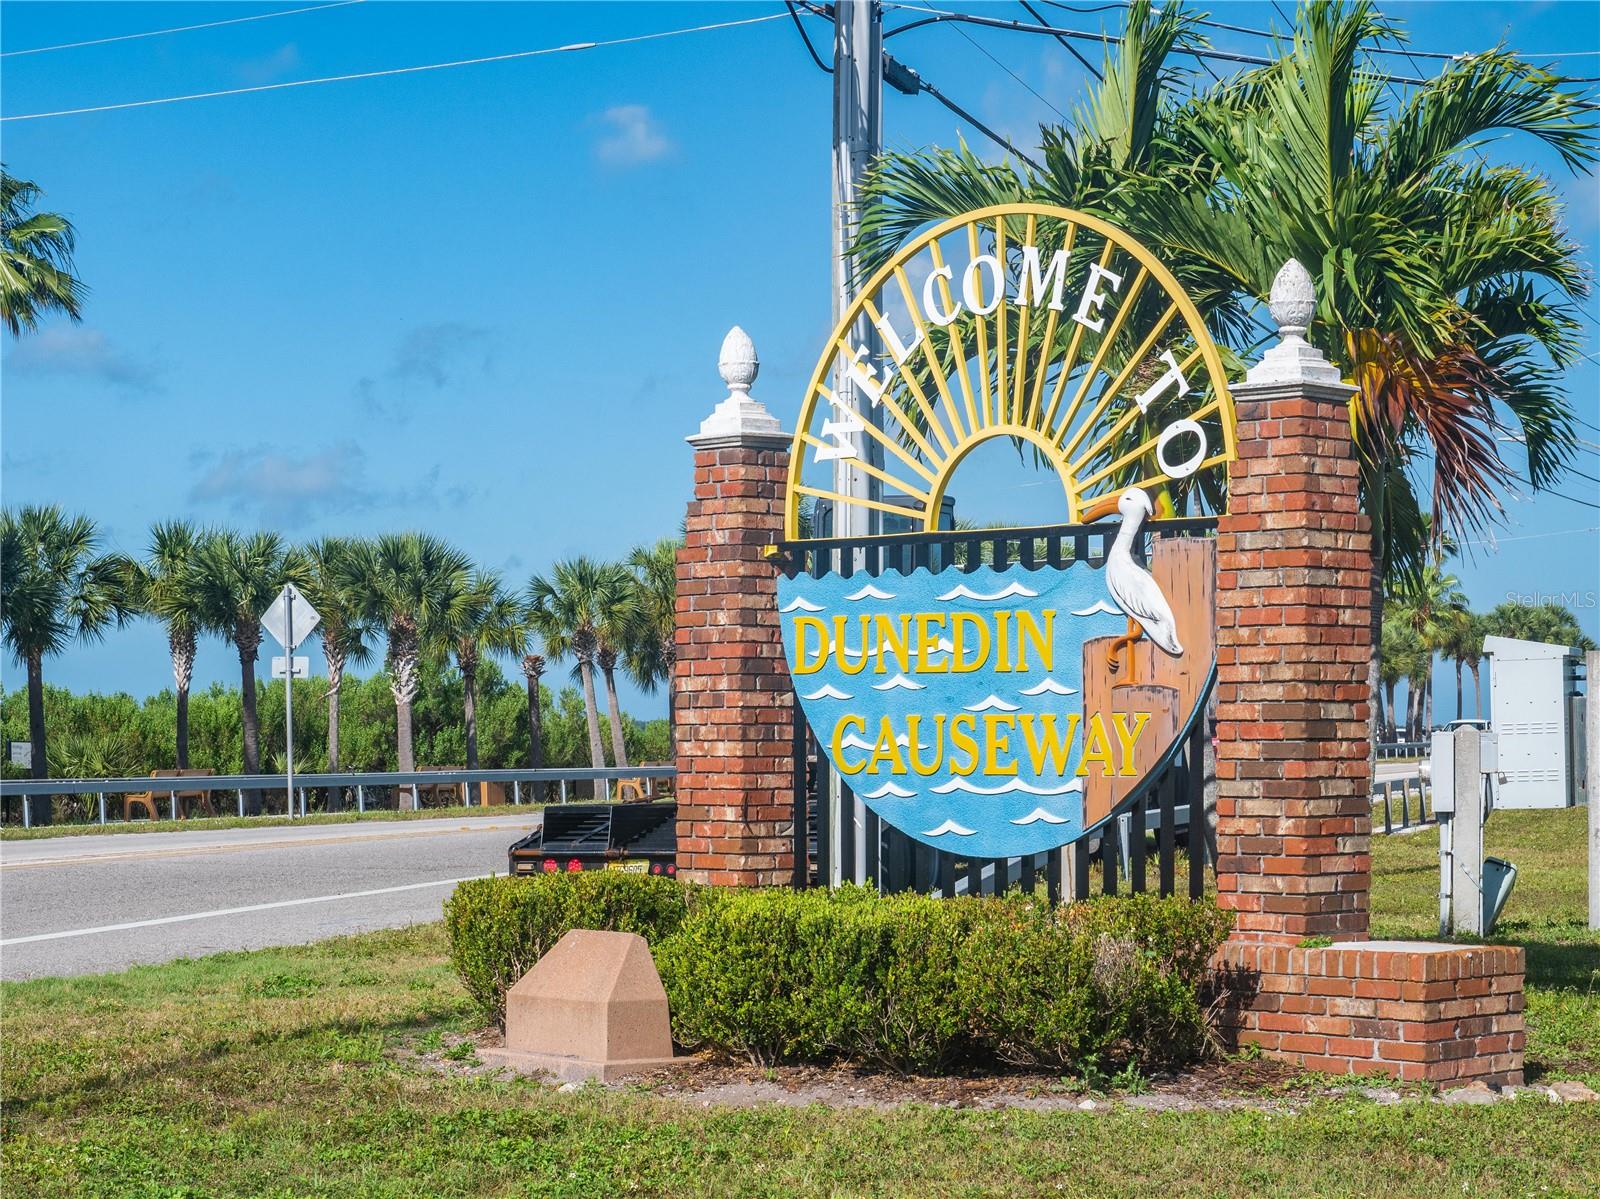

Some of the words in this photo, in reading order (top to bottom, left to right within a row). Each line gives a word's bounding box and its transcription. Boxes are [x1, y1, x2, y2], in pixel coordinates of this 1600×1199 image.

[813, 246, 1122, 464] WELCOME
[1135, 349, 1207, 479] TO
[793, 609, 1056, 674] DUNEDIN
[831, 711, 1151, 777] CAUSEWAY
